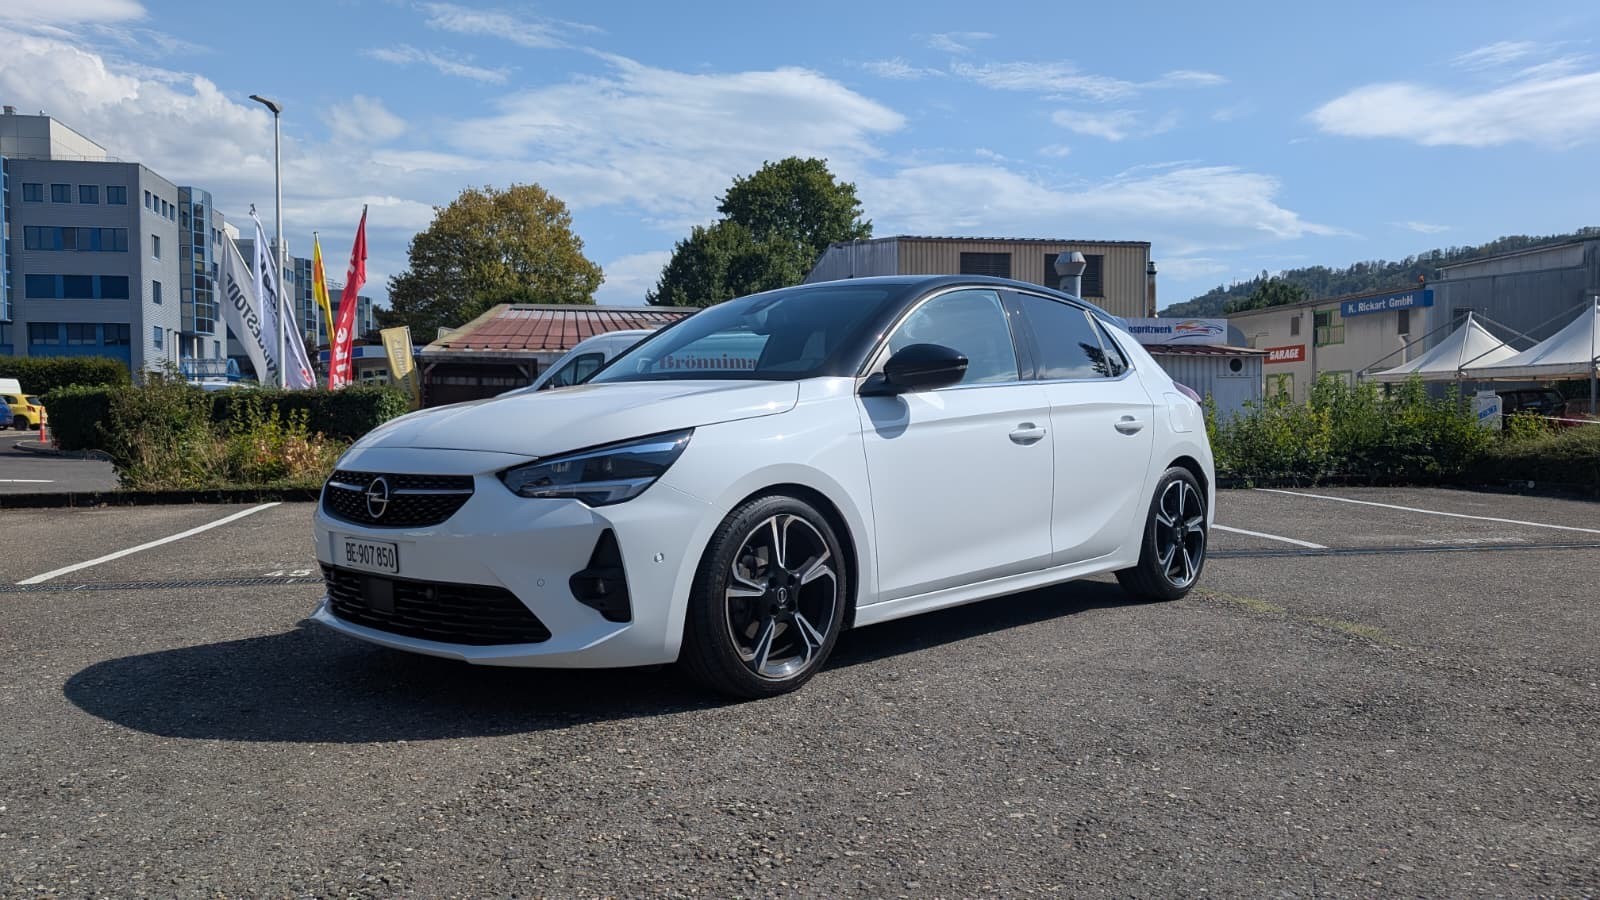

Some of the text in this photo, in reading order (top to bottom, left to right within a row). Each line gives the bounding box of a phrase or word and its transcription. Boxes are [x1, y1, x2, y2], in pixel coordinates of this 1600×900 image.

[1358, 299, 1386, 312] Rickart
[1388, 295, 1413, 308] GmbH
[1270, 348, 1299, 360] GARAGE
[376, 547, 394, 568] 850
